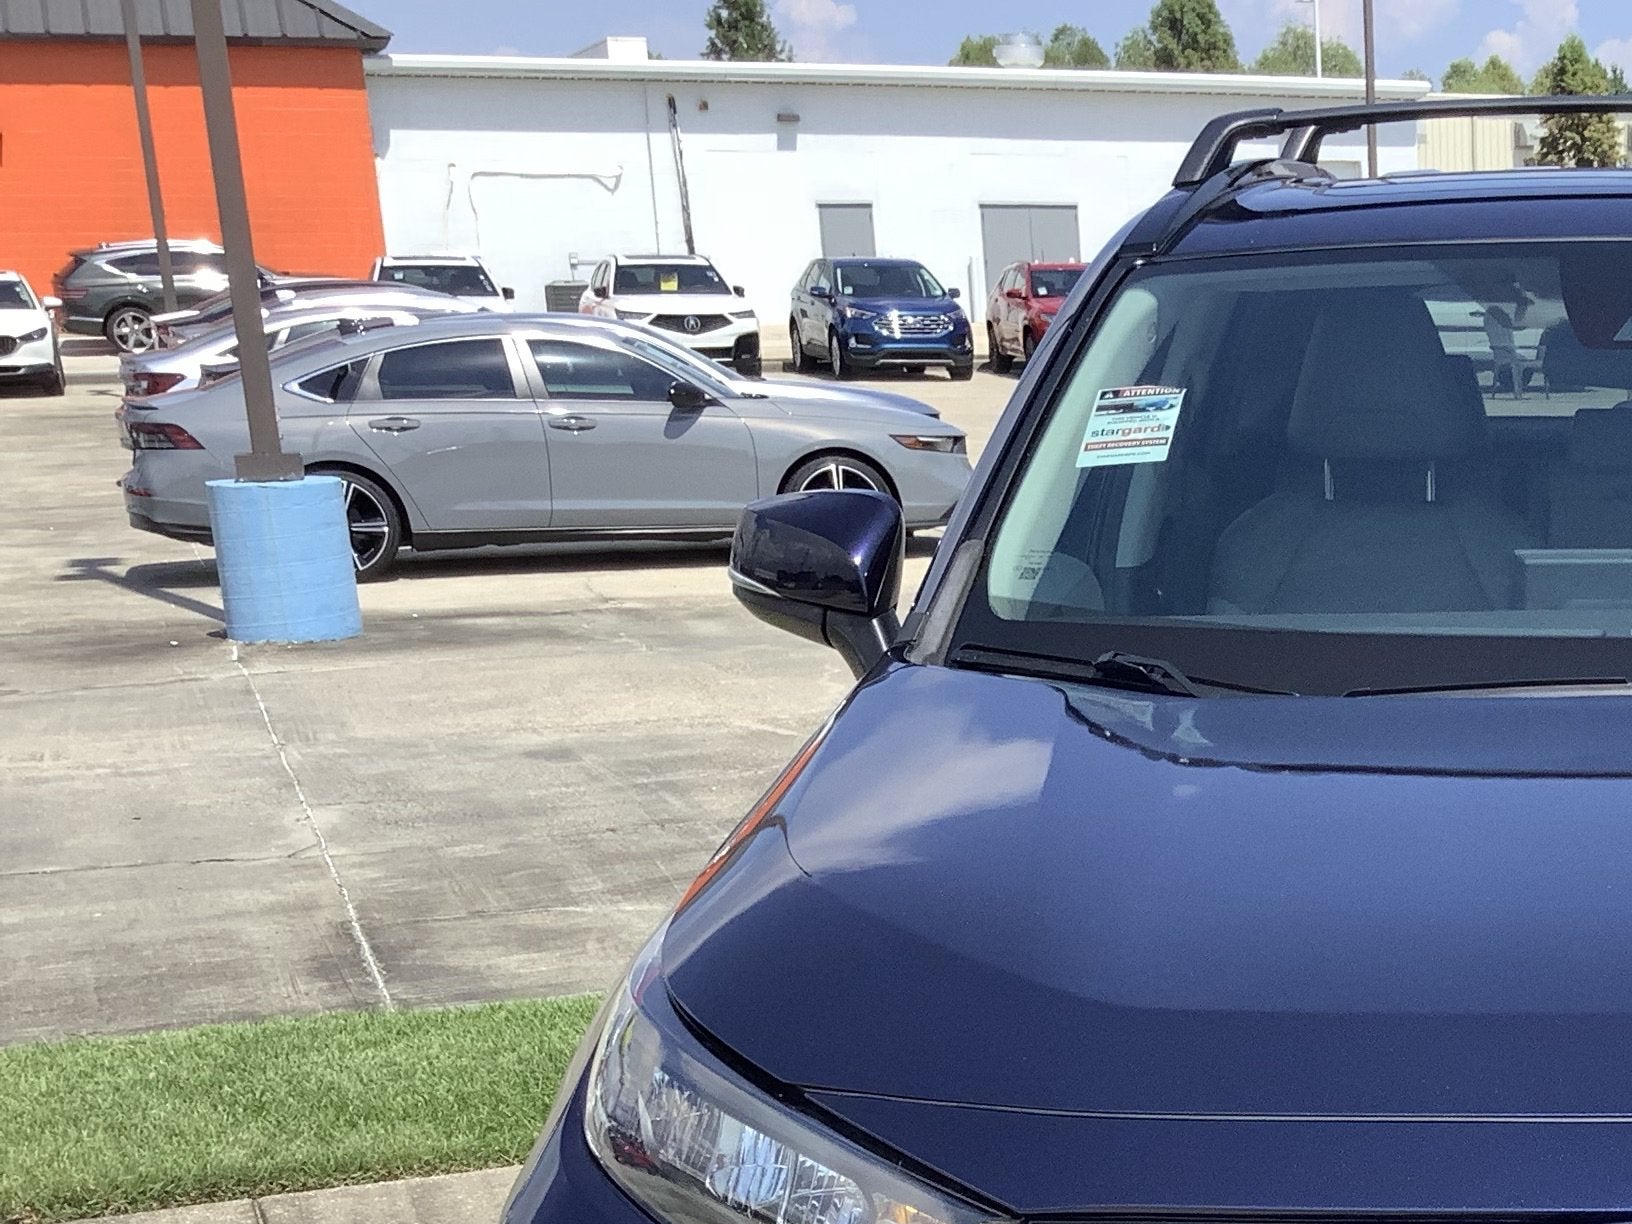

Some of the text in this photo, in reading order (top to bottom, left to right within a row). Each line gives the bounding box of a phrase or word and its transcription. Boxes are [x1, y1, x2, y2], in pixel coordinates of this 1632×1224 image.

[1122, 387, 1181, 397] ATTENTION
[1091, 423, 1162, 438] stargard
[1107, 440, 1141, 448] RECOVERY
[1141, 438, 1167, 446] SYSTEM
